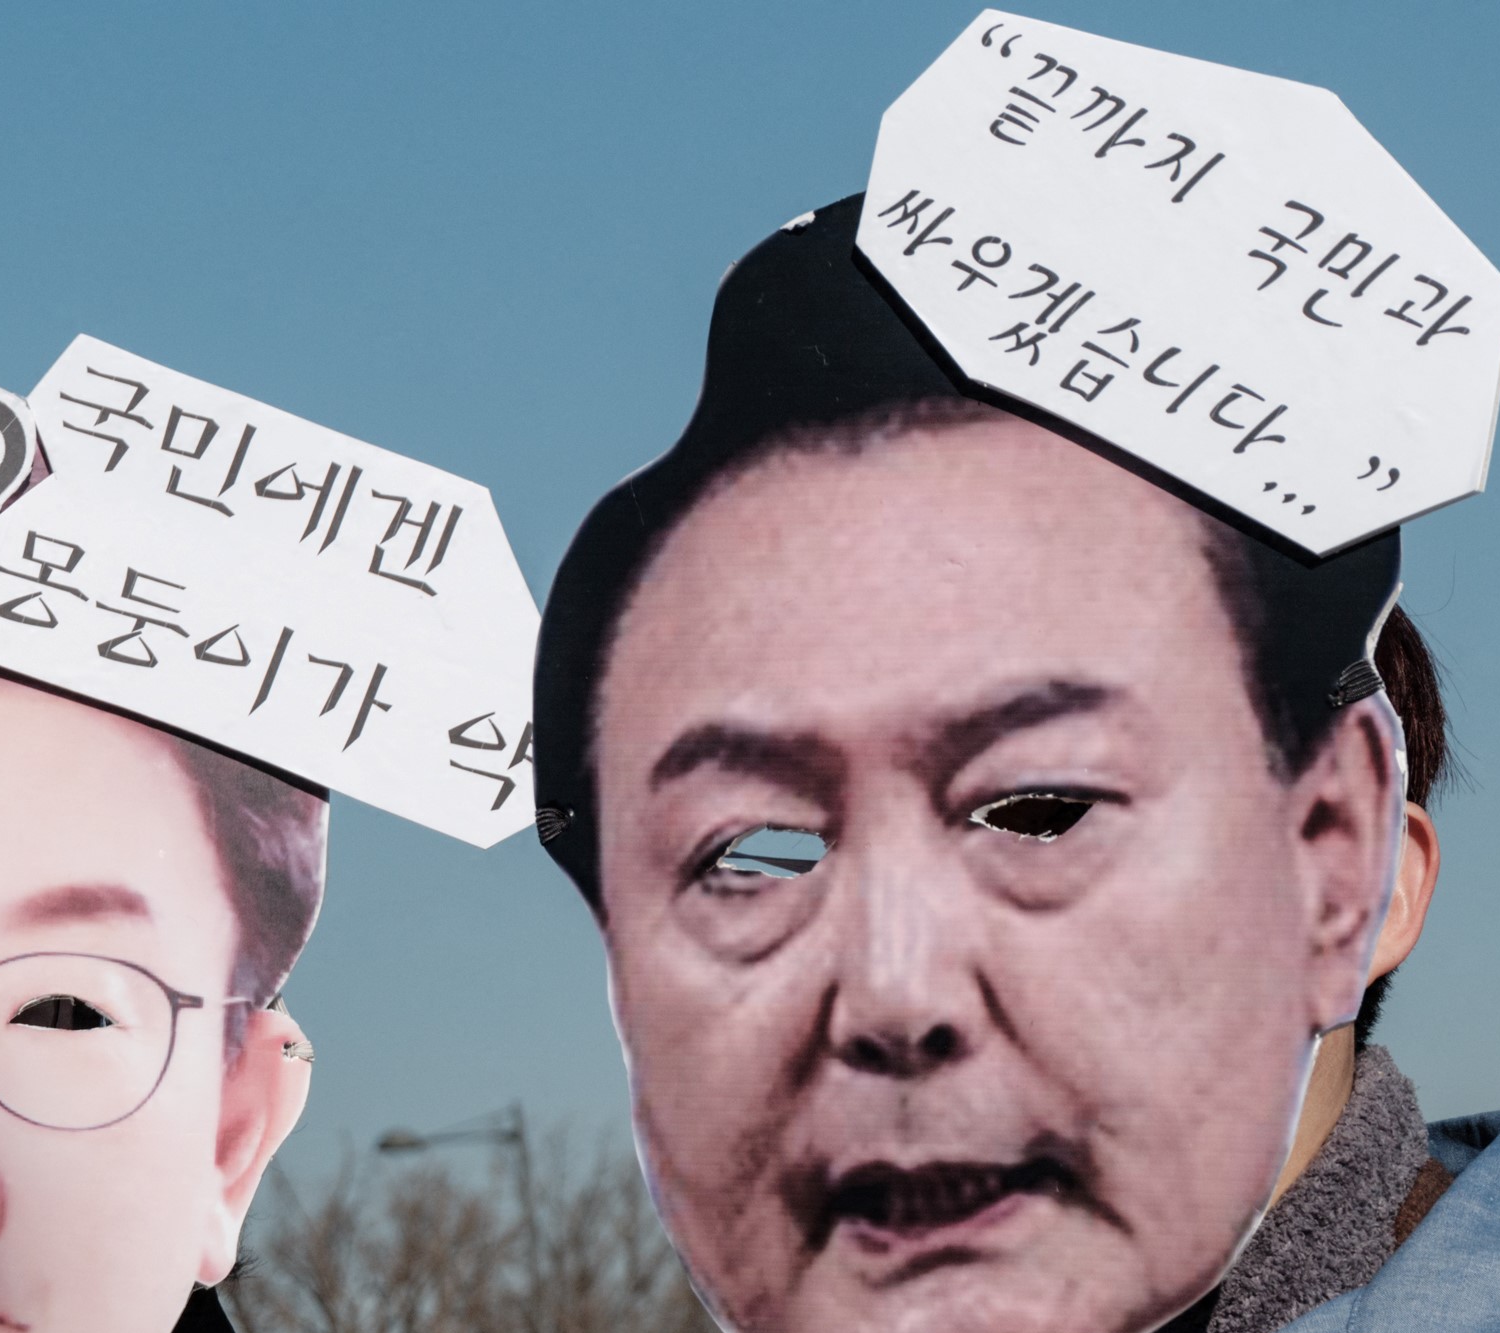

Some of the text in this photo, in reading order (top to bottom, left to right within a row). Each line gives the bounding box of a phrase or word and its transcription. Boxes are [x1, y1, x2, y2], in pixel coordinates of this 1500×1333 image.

[981, 23, 1473, 347] “끝까지 국민과
[59, 365, 464, 597] 국민에겐
